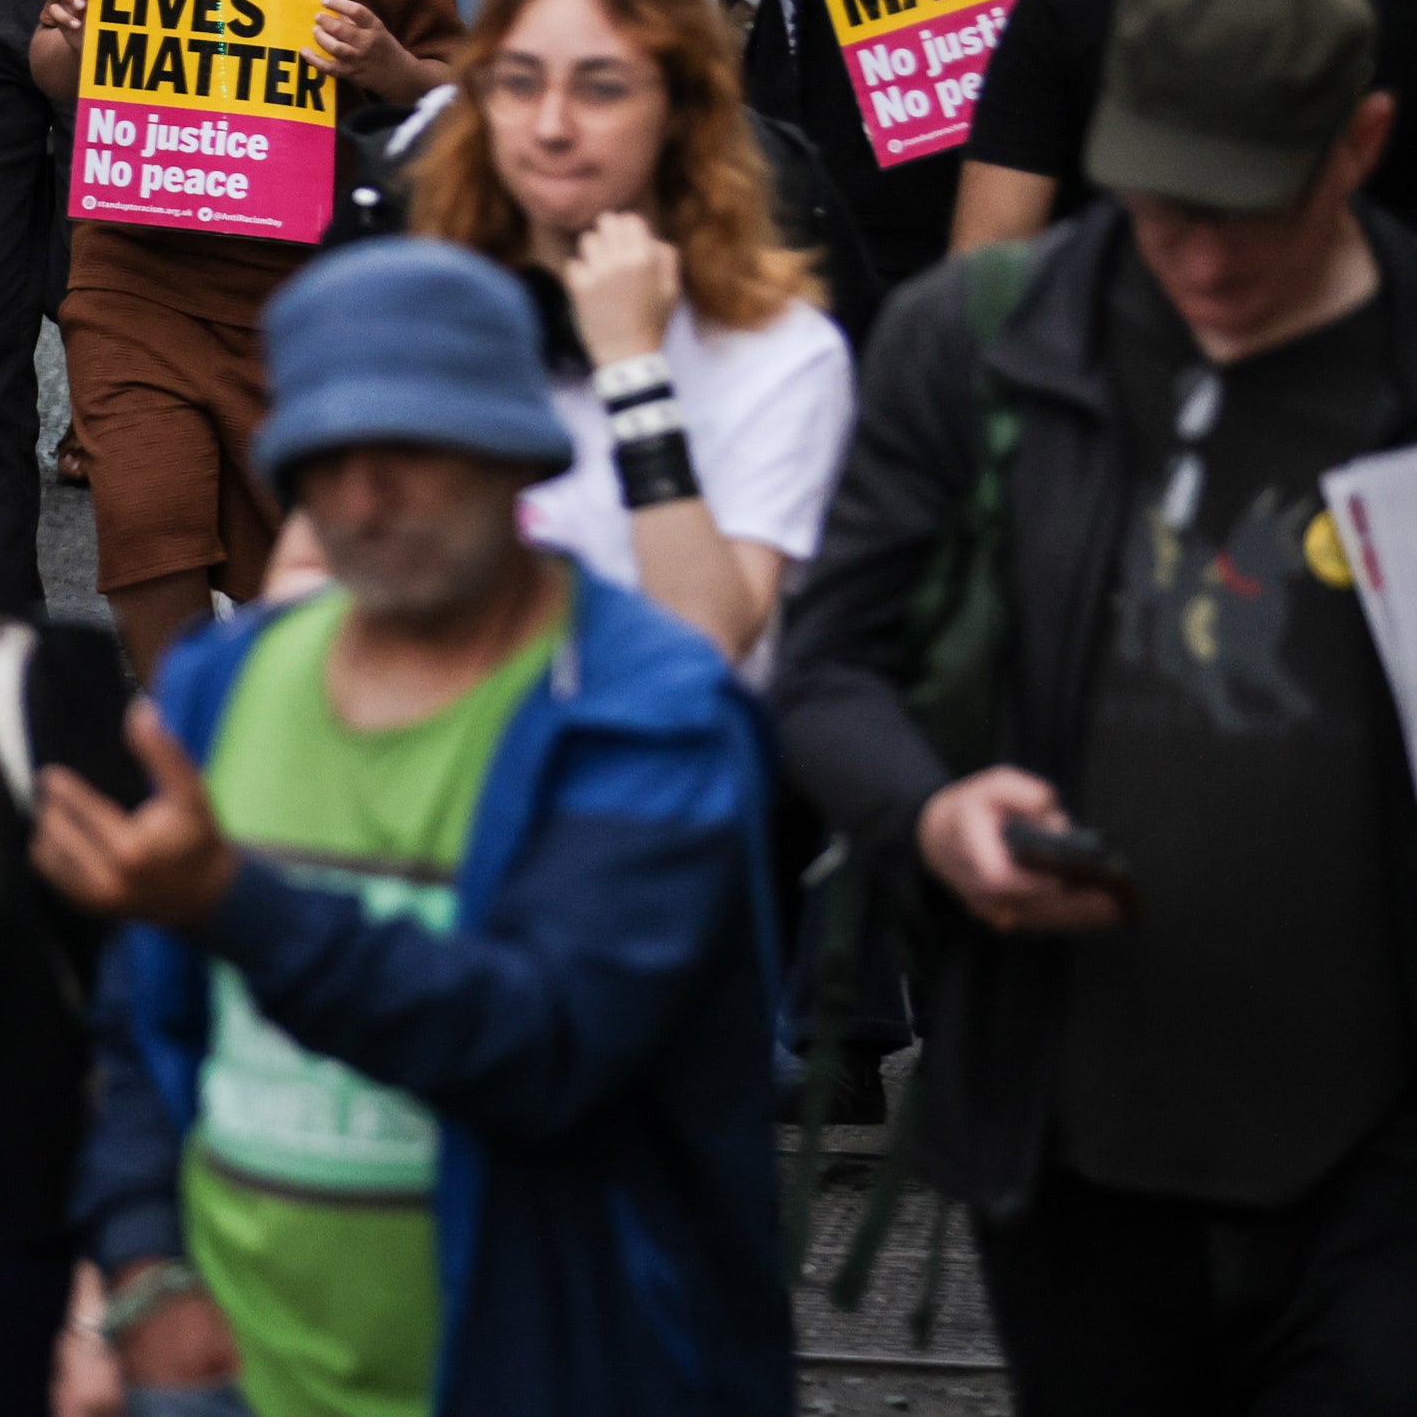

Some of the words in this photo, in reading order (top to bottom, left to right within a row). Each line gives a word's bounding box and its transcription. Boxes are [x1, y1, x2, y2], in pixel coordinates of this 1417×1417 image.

[93, 28, 327, 112] MATTER
[856, 41, 917, 86] No
[920, 6, 1007, 79] justi
[870, 85, 931, 129] No
[86, 107, 137, 148] No
[140, 112, 270, 161] justice
[82, 148, 133, 188] No
[139, 160, 250, 200] peace
[96, 200, 194, 218] standuptoracism.org.uk
[213, 212, 284, 229] @AntiRacismDay
